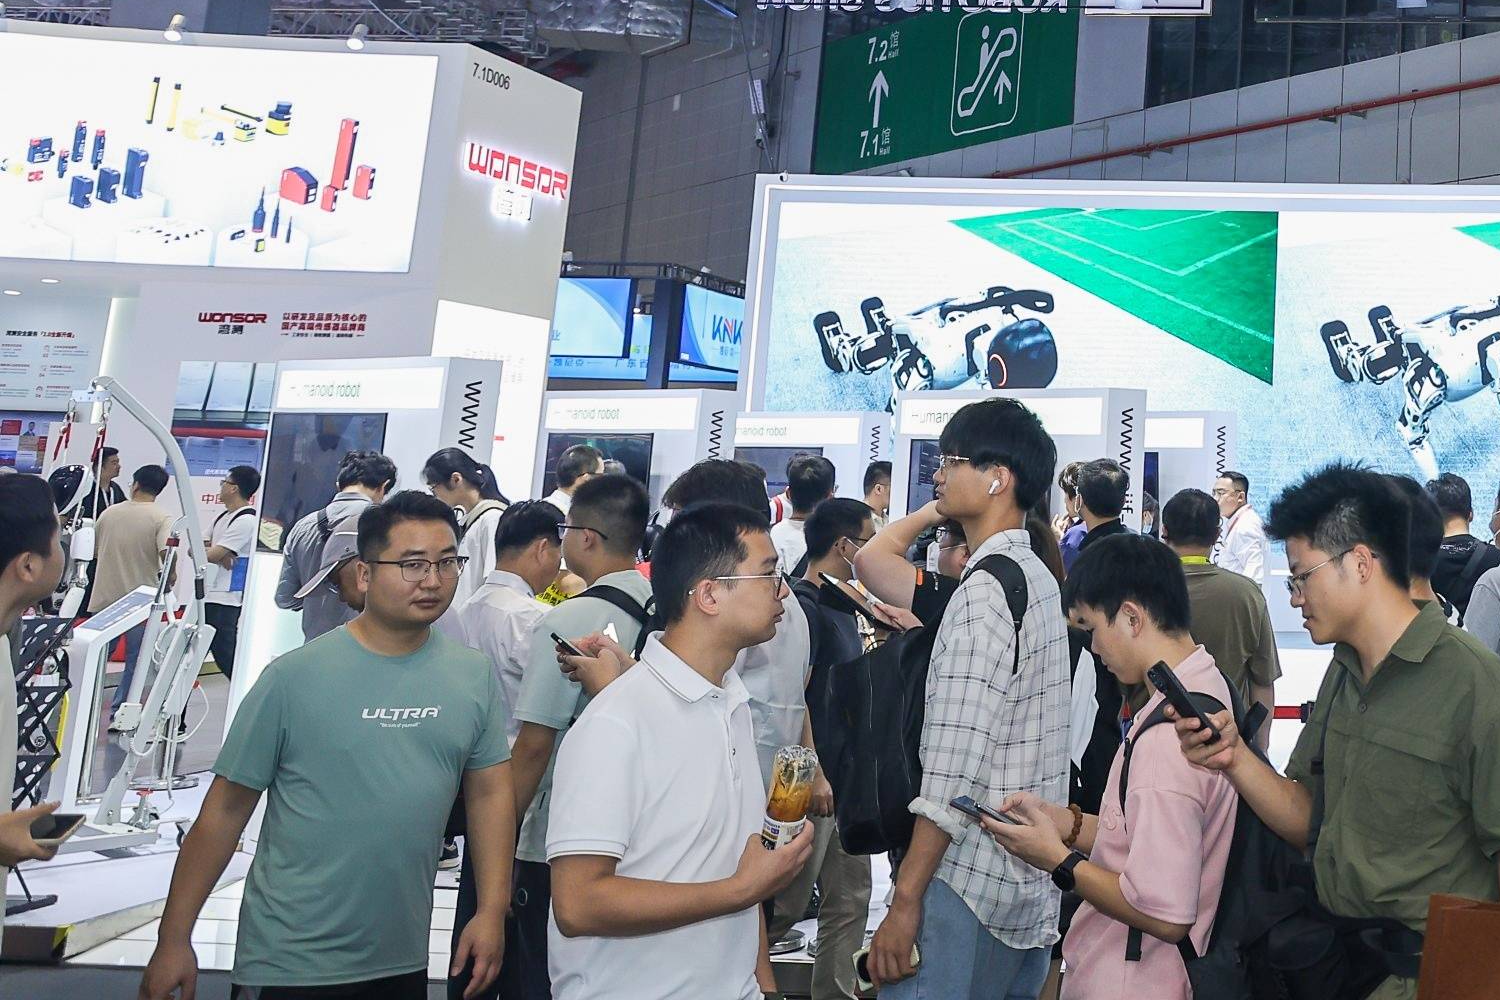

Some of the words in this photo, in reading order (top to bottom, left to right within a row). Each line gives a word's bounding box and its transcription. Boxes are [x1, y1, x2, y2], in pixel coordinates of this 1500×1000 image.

[868, 36, 888, 65] 7.2
[889, 30, 899, 48] 馆
[888, 49, 899, 59] Hall
[472, 62, 511, 90] 7.1D006
[860, 130, 879, 158] 7.1
[881, 127, 891, 145] 馆
[879, 146, 891, 156] Hall
[334, 383, 361, 398] robot
[597, 408, 621, 420] robot
[362, 707, 438, 720] ULTRA
